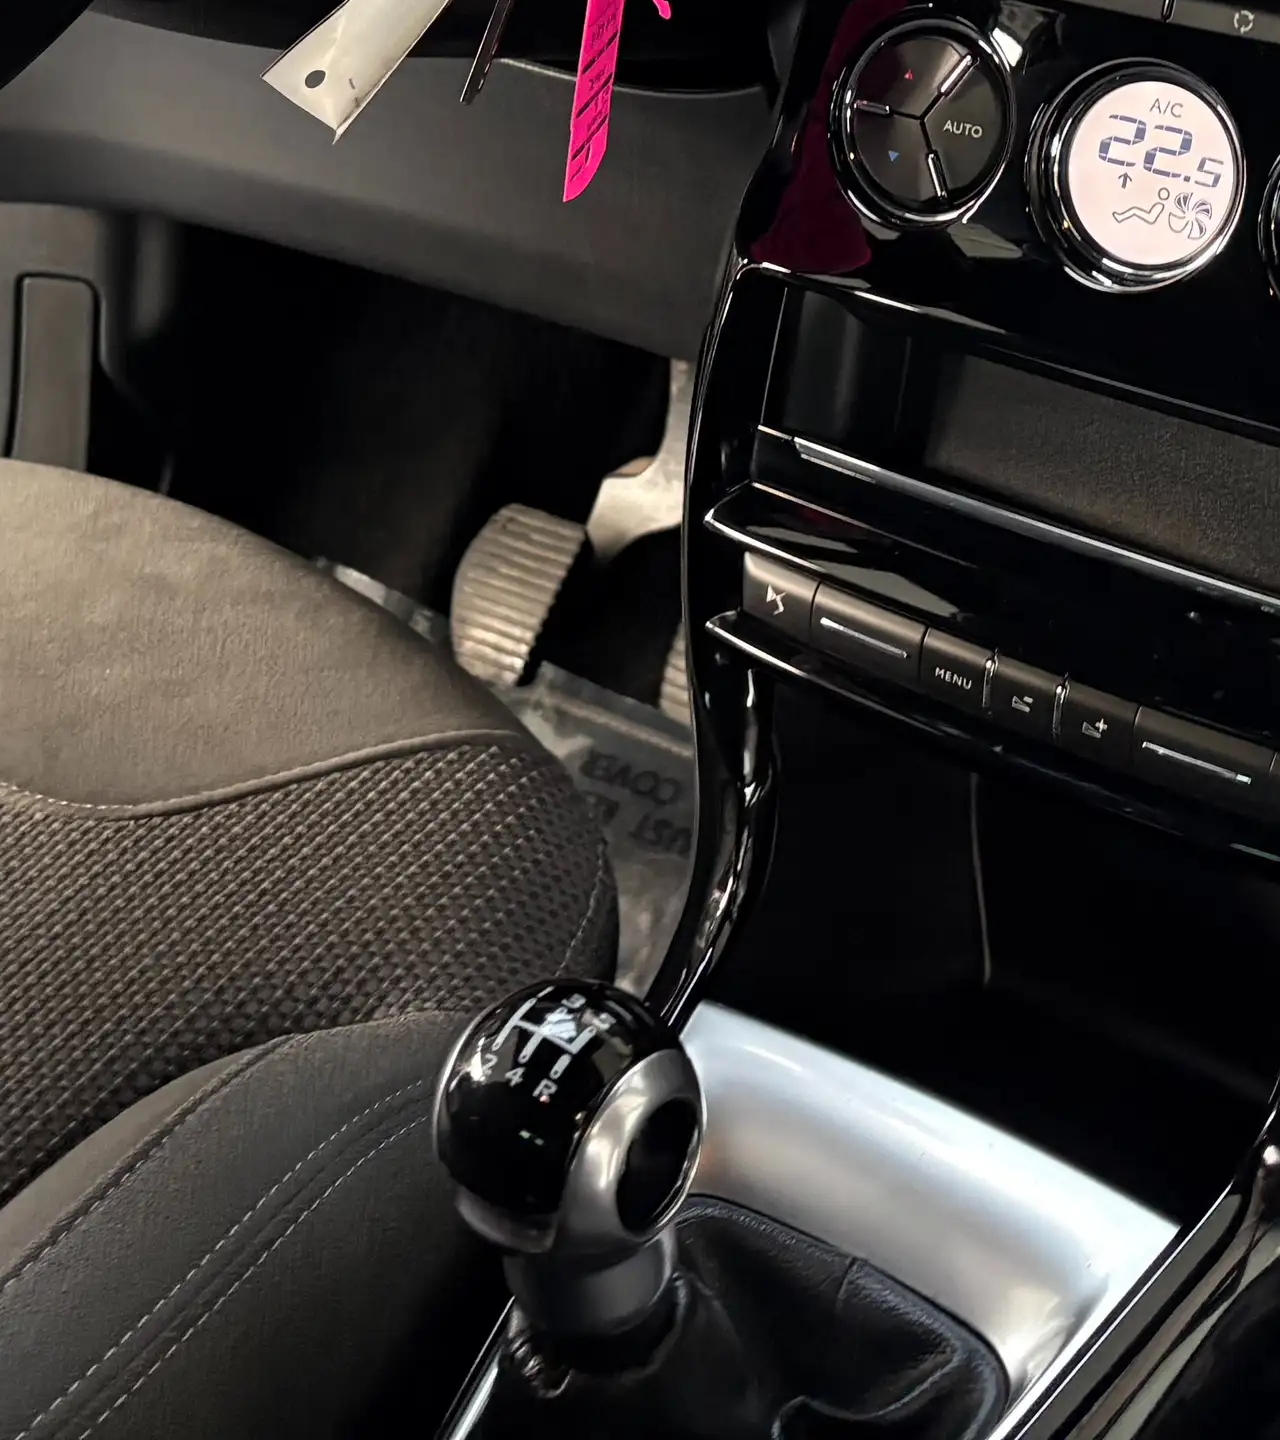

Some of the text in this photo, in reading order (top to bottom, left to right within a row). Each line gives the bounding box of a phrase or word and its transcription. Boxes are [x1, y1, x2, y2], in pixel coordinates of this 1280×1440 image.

[1149, 98, 1184, 118] A/C
[943, 120, 983, 138] AUTO
[1098, 114, 1224, 188] 22.5
[935, 666, 972, 690] MENU
[505, 1066, 526, 1087] 4
[532, 1079, 559, 1098] R
